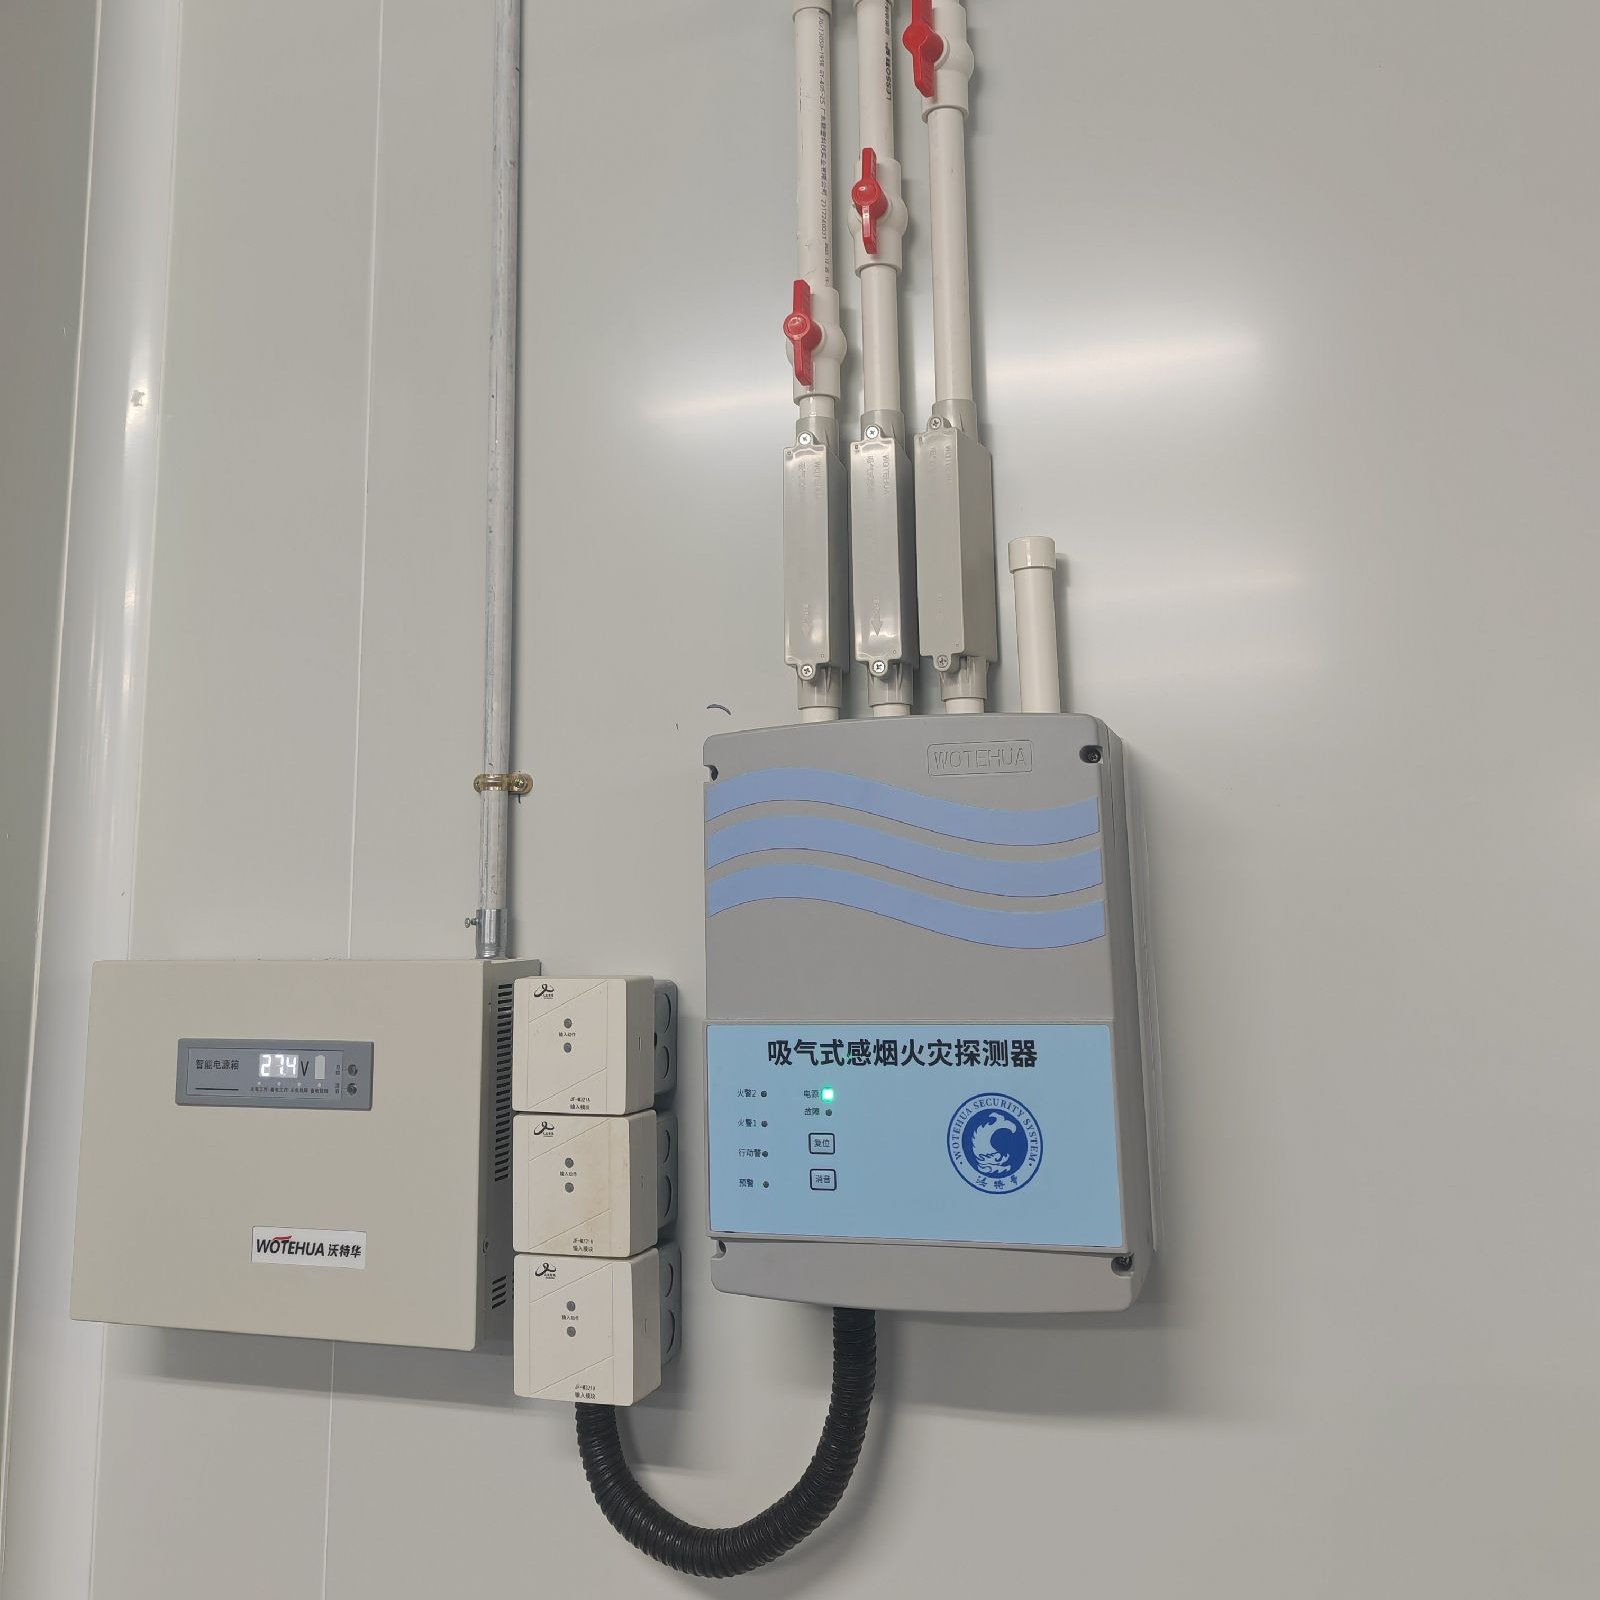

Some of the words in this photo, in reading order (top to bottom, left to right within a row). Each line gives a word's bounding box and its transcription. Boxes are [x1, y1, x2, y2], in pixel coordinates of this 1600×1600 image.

[933, 747, 1027, 770] WOTEHUA
[767, 1038, 1038, 1068] 吸气式感烟火灾探测器
[195, 1059, 240, 1070] 智能电源箱
[301, 1061, 309, 1077] V
[737, 1089, 757, 1098] 火警2
[803, 1089, 820, 1099] 电源
[737, 1118, 757, 1127] 火警1
[952, 1107, 973, 1160] WOTEHUA
[973, 1098, 1025, 1118] SECURITY
[1022, 1118, 1039, 1162] SYSTEM
[813, 1138, 831, 1148] 复位
[738, 1148, 762, 1158] 行动警
[738, 1178, 754, 1188] 预警
[256, 1238, 325, 1257] WOTEHUA
[327, 1243, 362, 1258] 沃特华
